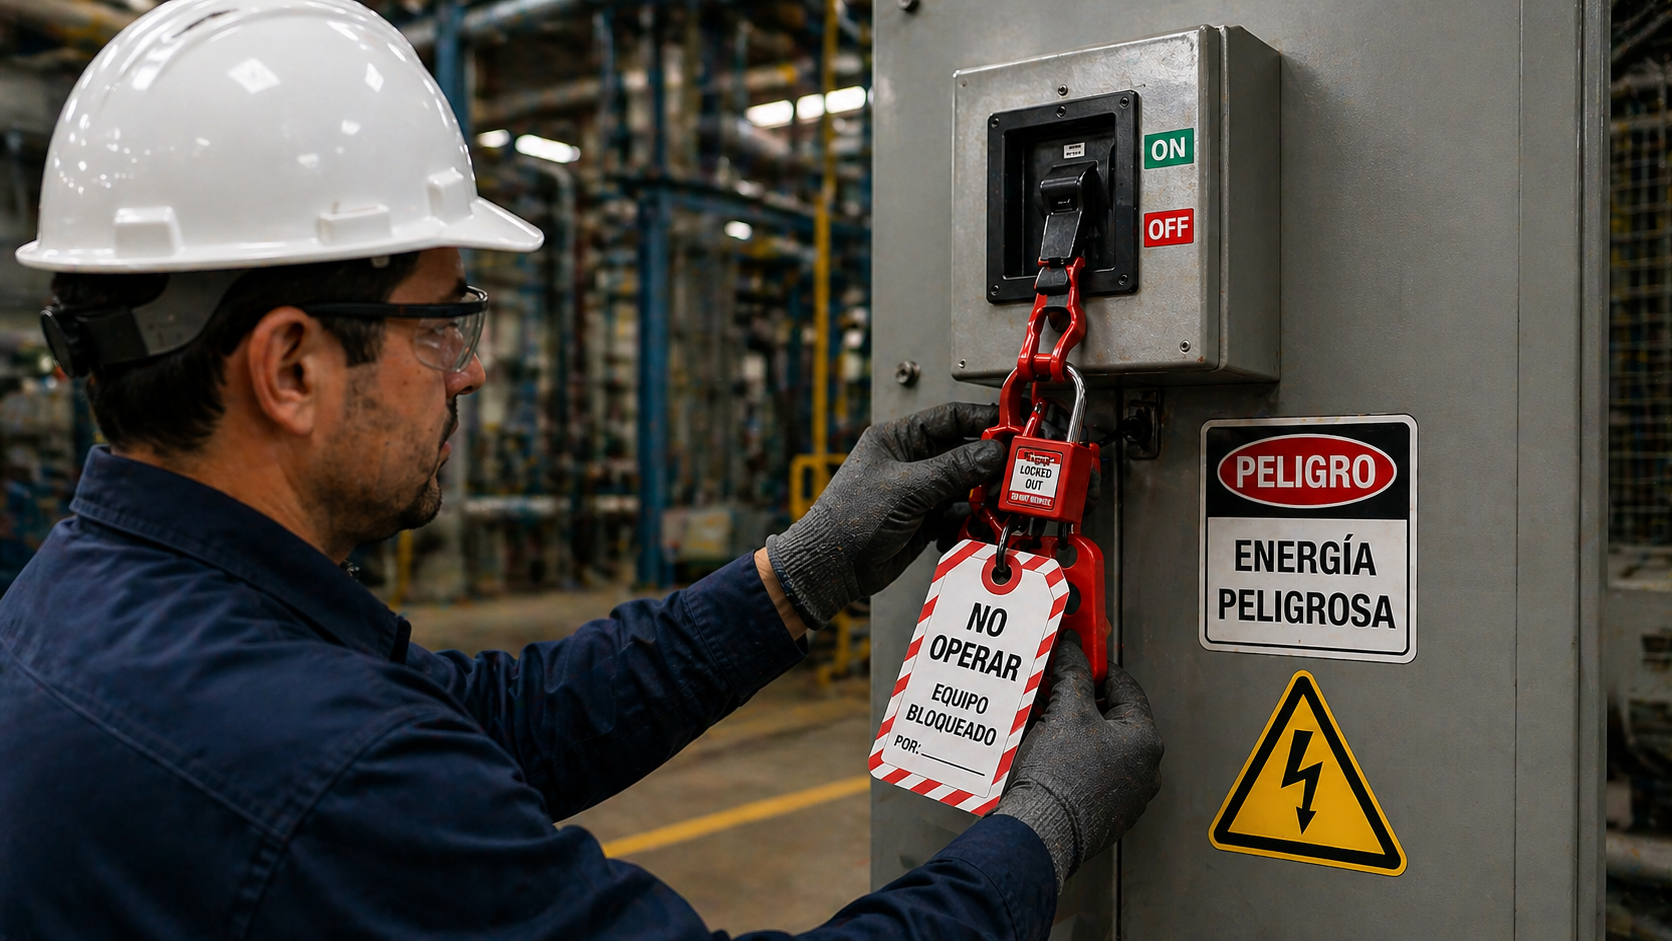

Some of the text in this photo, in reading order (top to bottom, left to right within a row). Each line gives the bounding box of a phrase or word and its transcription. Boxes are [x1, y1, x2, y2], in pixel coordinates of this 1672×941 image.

[1151, 137, 1186, 161] ON
[1148, 216, 1189, 240] OFF
[1020, 465, 1052, 478] LOCKED
[1025, 479, 1043, 491] OUT
[1236, 454, 1376, 489] PELIGRO
[1235, 533, 1377, 576] ENERGÍA
[966, 602, 1008, 637] NO
[1218, 588, 1396, 629] PELIGROSA
[930, 635, 1022, 681] OPERAR
[931, 683, 989, 714] EQUIPO
[905, 703, 997, 746] BLOQUEADO
[894, 735, 922, 754] POR:
